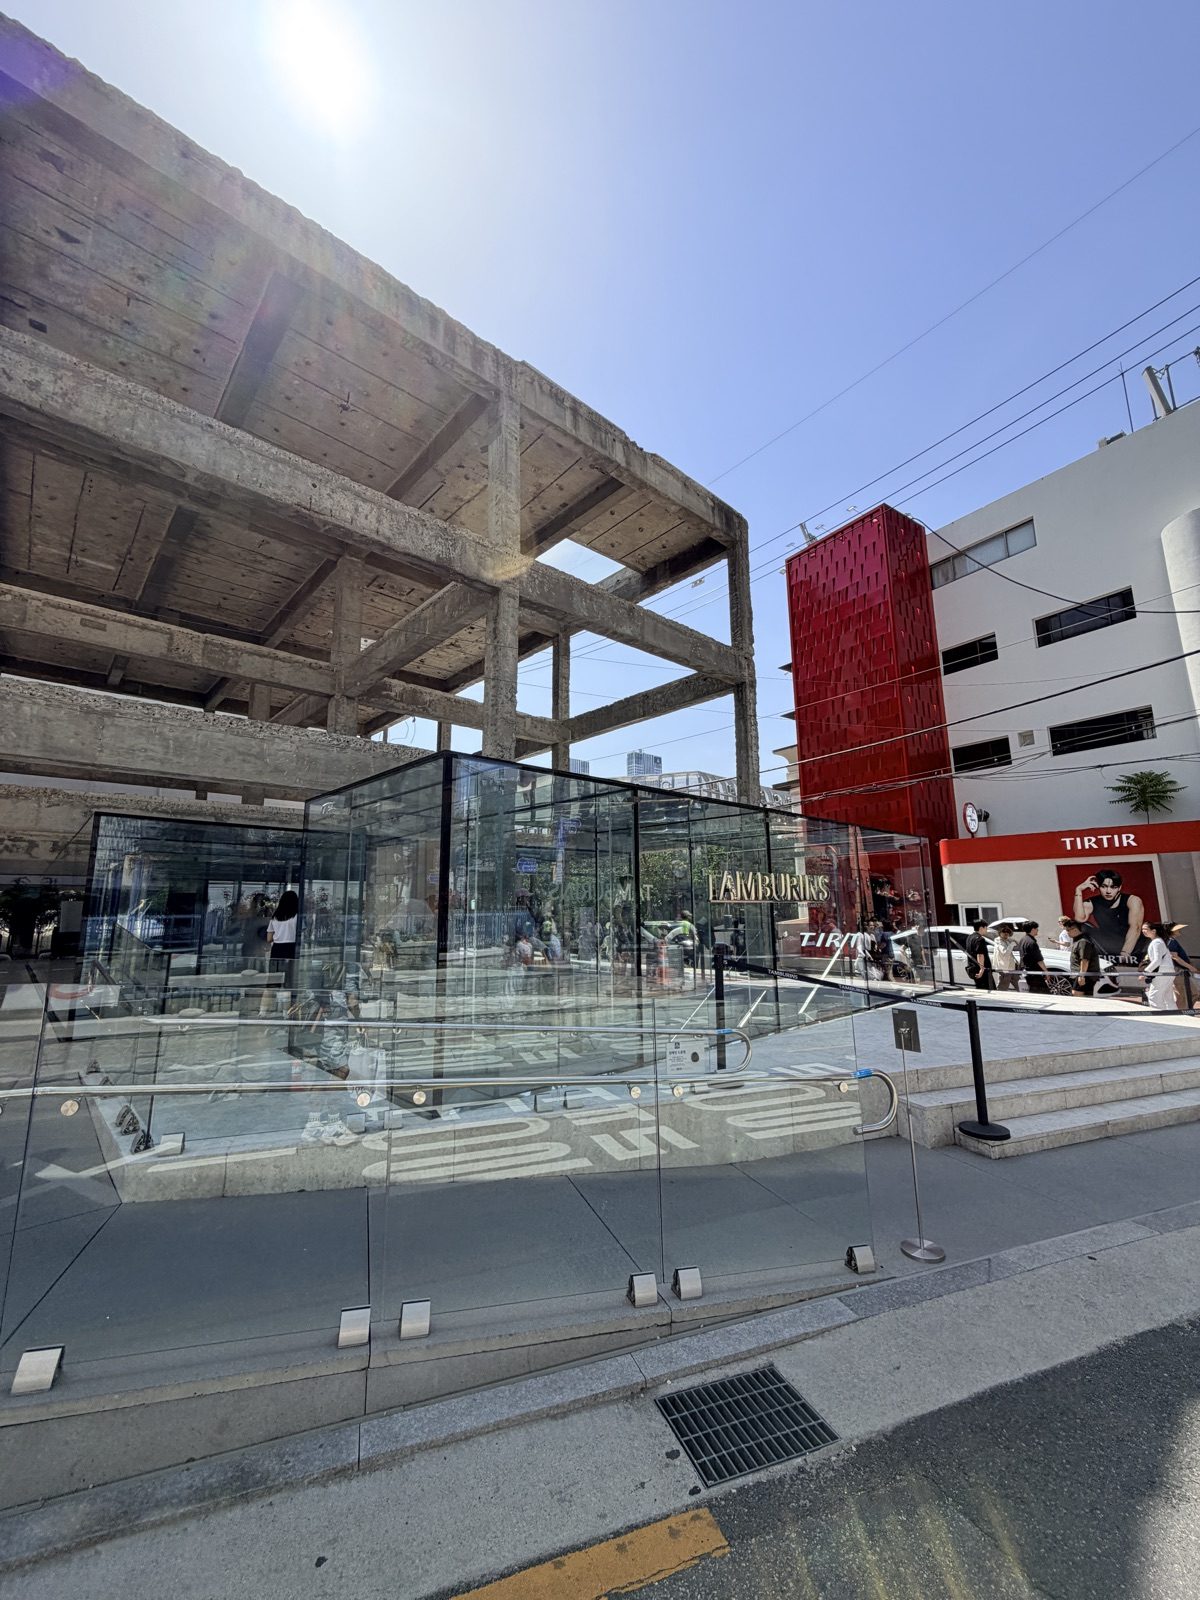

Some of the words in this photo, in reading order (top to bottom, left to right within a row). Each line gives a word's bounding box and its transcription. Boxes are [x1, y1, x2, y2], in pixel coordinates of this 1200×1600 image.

[1061, 833, 1138, 850] TIRTIR
[705, 870, 831, 901] TAMBURINS
[767, 969, 799, 980] TAMBURINS
